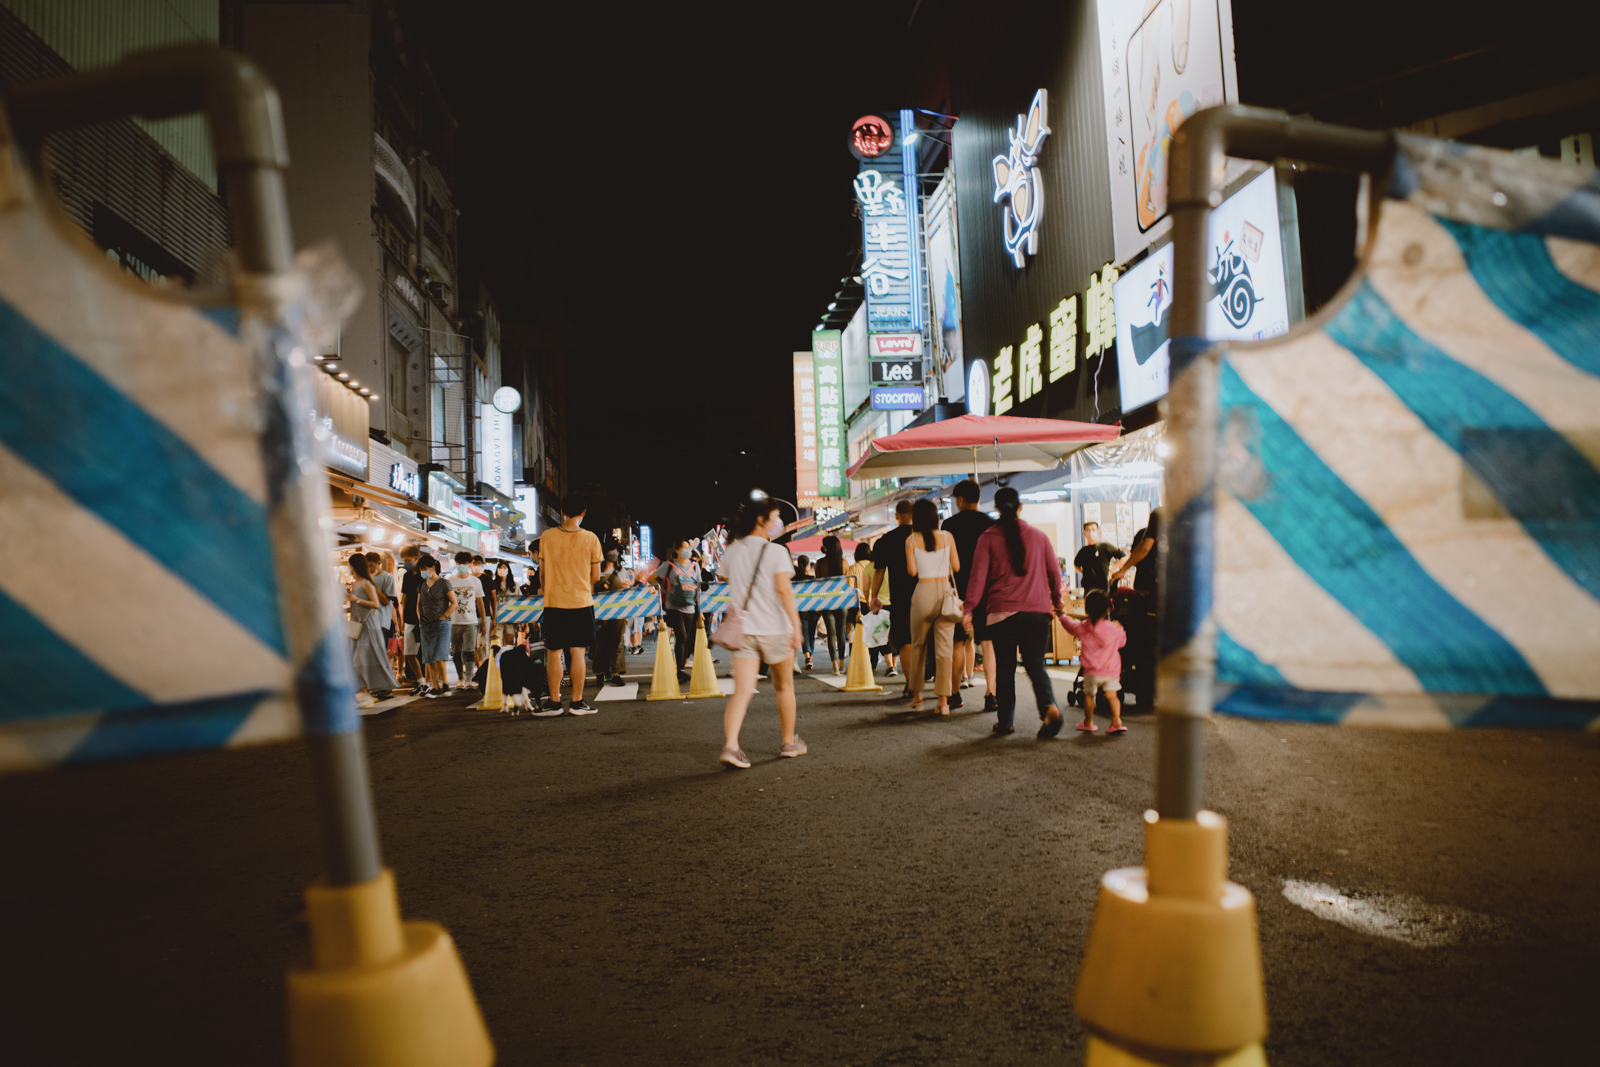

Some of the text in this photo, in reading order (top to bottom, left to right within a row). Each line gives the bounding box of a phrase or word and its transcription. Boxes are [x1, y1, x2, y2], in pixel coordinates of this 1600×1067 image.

[873, 306, 909, 318] JEANS
[815, 341, 839, 351] TOP
[992, 262, 1119, 417] 老虎蜜蜂
[881, 361, 913, 381] Lee
[875, 392, 922, 405] STOCKTON
[818, 365, 842, 488] 高點流行廣場
